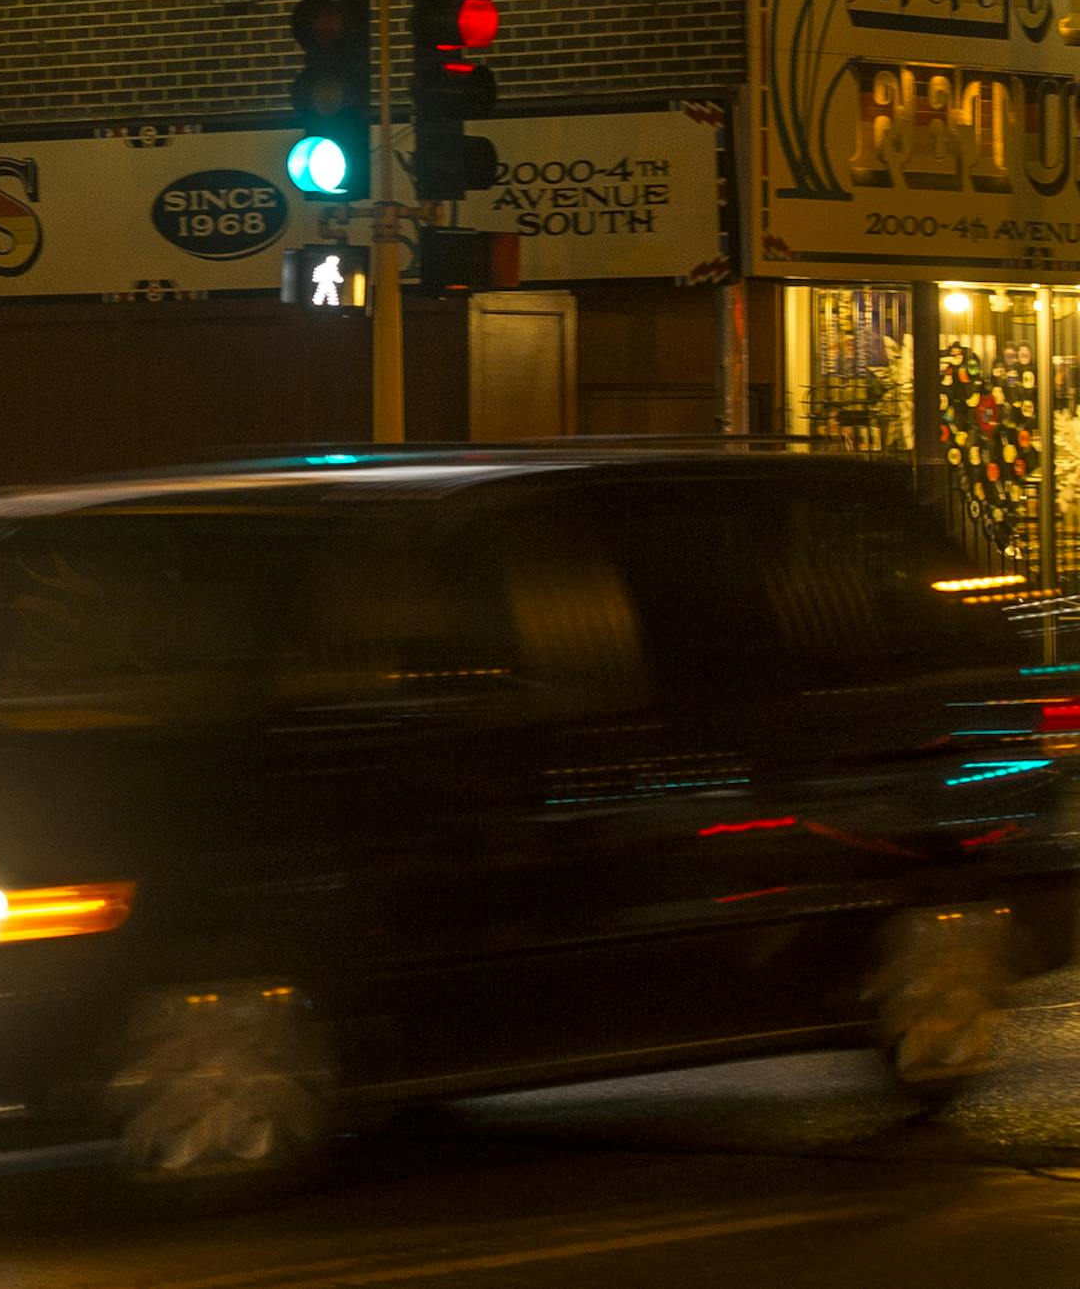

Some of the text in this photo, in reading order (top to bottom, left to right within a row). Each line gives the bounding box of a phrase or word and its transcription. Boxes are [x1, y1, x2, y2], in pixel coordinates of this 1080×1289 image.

[162, 187, 278, 213] SINCE
[493, 184, 671, 211] AVENUE
[177, 212, 267, 237] 1968
[517, 210, 658, 237] SOUTH
